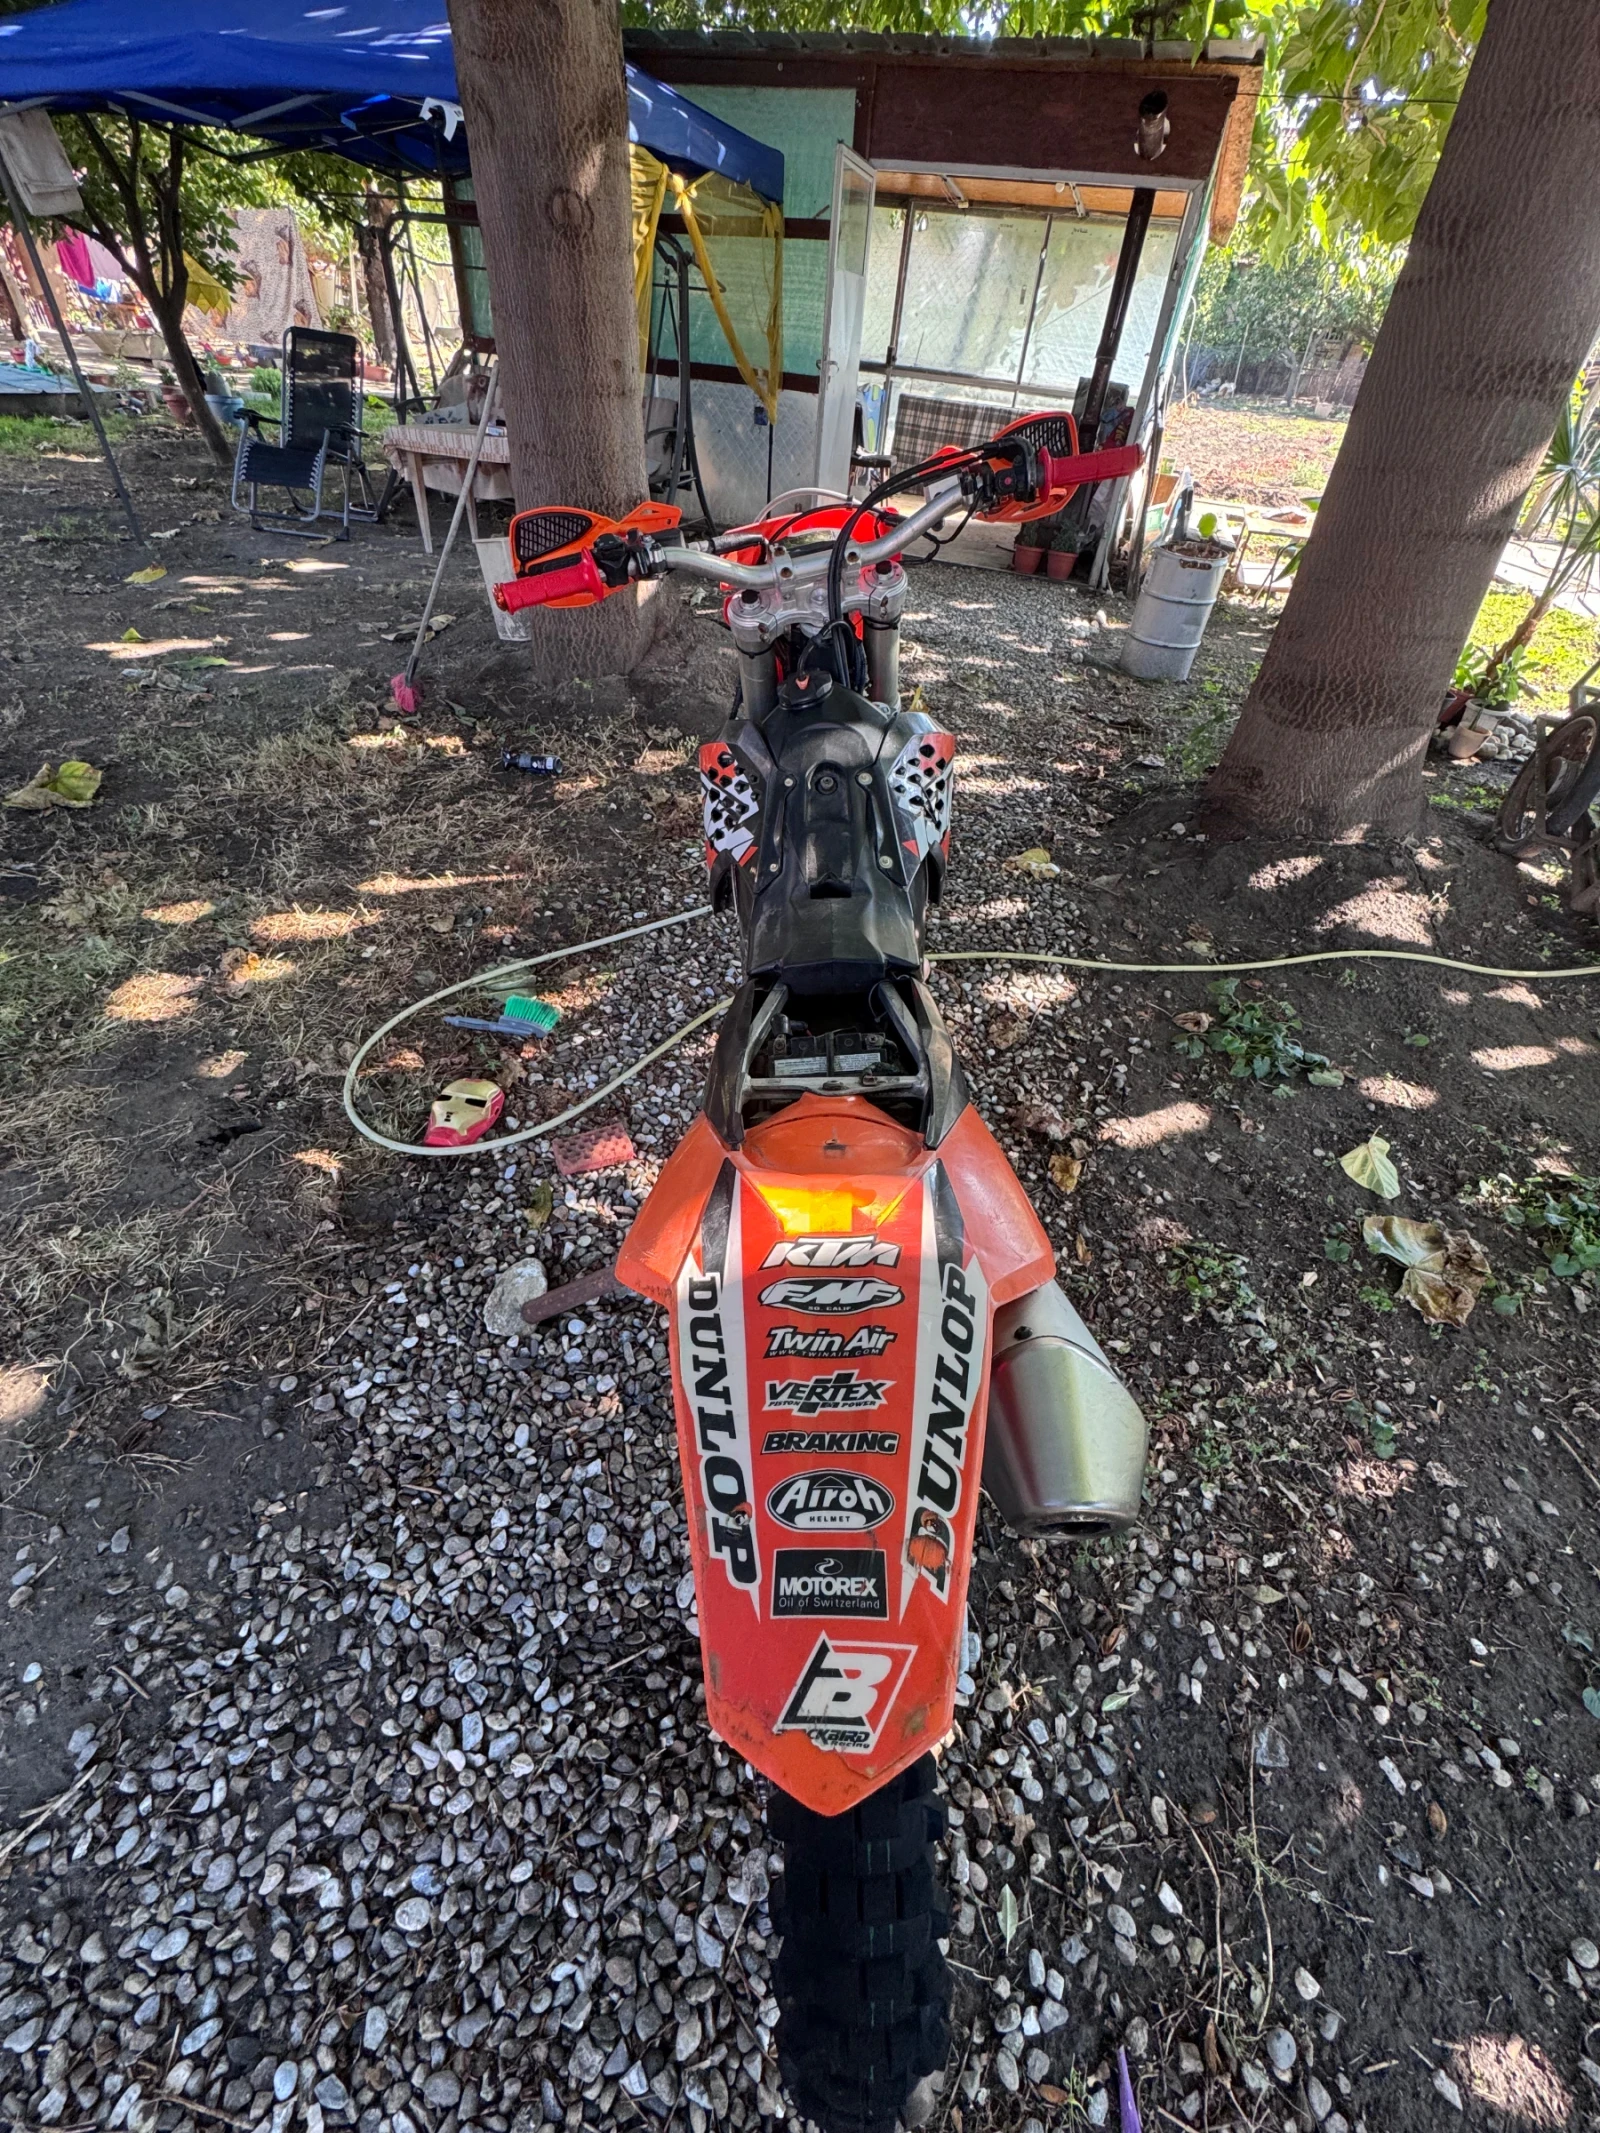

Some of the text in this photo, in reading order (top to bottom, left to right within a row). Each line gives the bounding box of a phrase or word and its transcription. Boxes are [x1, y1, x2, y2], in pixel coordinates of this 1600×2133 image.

[760, 1236, 900, 1268] KTM
[762, 1281, 900, 1304] FMF
[769, 1327, 895, 1352] Twin Air
[769, 1348, 880, 1357] WWW.TWINAIR.COM
[769, 1381, 887, 1401] VERTEX
[688, 1276, 758, 1584] DUNLOP
[764, 1432, 898, 1453] BRAKING
[775, 1479, 885, 1515] Airoh
[809, 1515, 851, 1523] HELMET
[779, 1576, 878, 1597] MOTOREX
[779, 1597, 880, 1609] Oil of Switzerland
[830, 1740, 870, 1749] Racing
